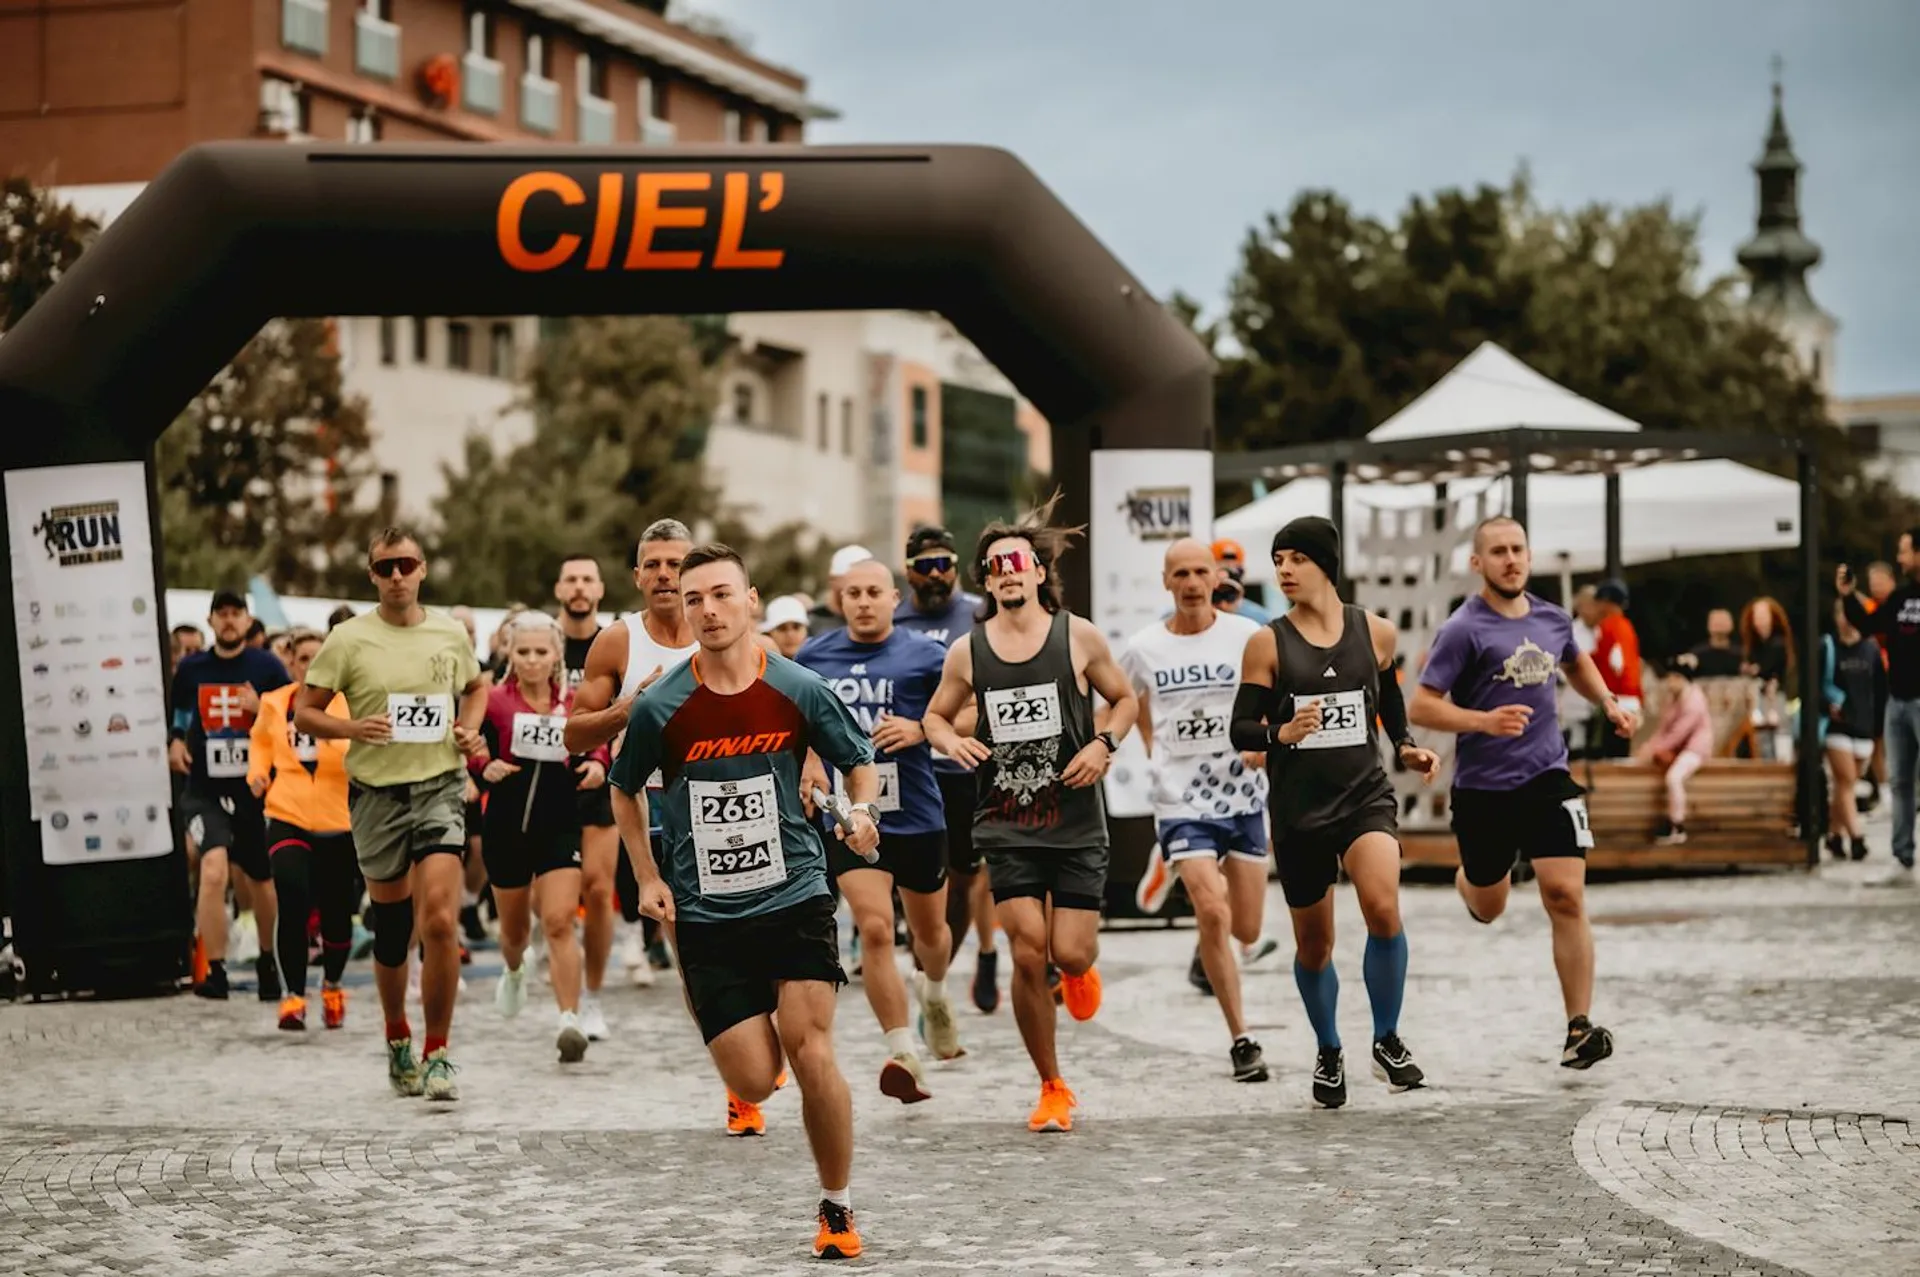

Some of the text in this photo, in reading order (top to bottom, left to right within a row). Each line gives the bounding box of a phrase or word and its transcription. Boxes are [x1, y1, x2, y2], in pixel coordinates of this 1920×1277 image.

[1137, 499, 1190, 528] RUN
[55, 515, 121, 551] RUN
[397, 707, 441, 728] 267
[998, 698, 1048, 726] 223
[1320, 706, 1355, 731] 25
[523, 725, 562, 746] 250
[1177, 716, 1224, 741] 222
[686, 731, 791, 762] DYNAFIT
[702, 794, 764, 823] 268
[709, 846, 770, 871] 292A
